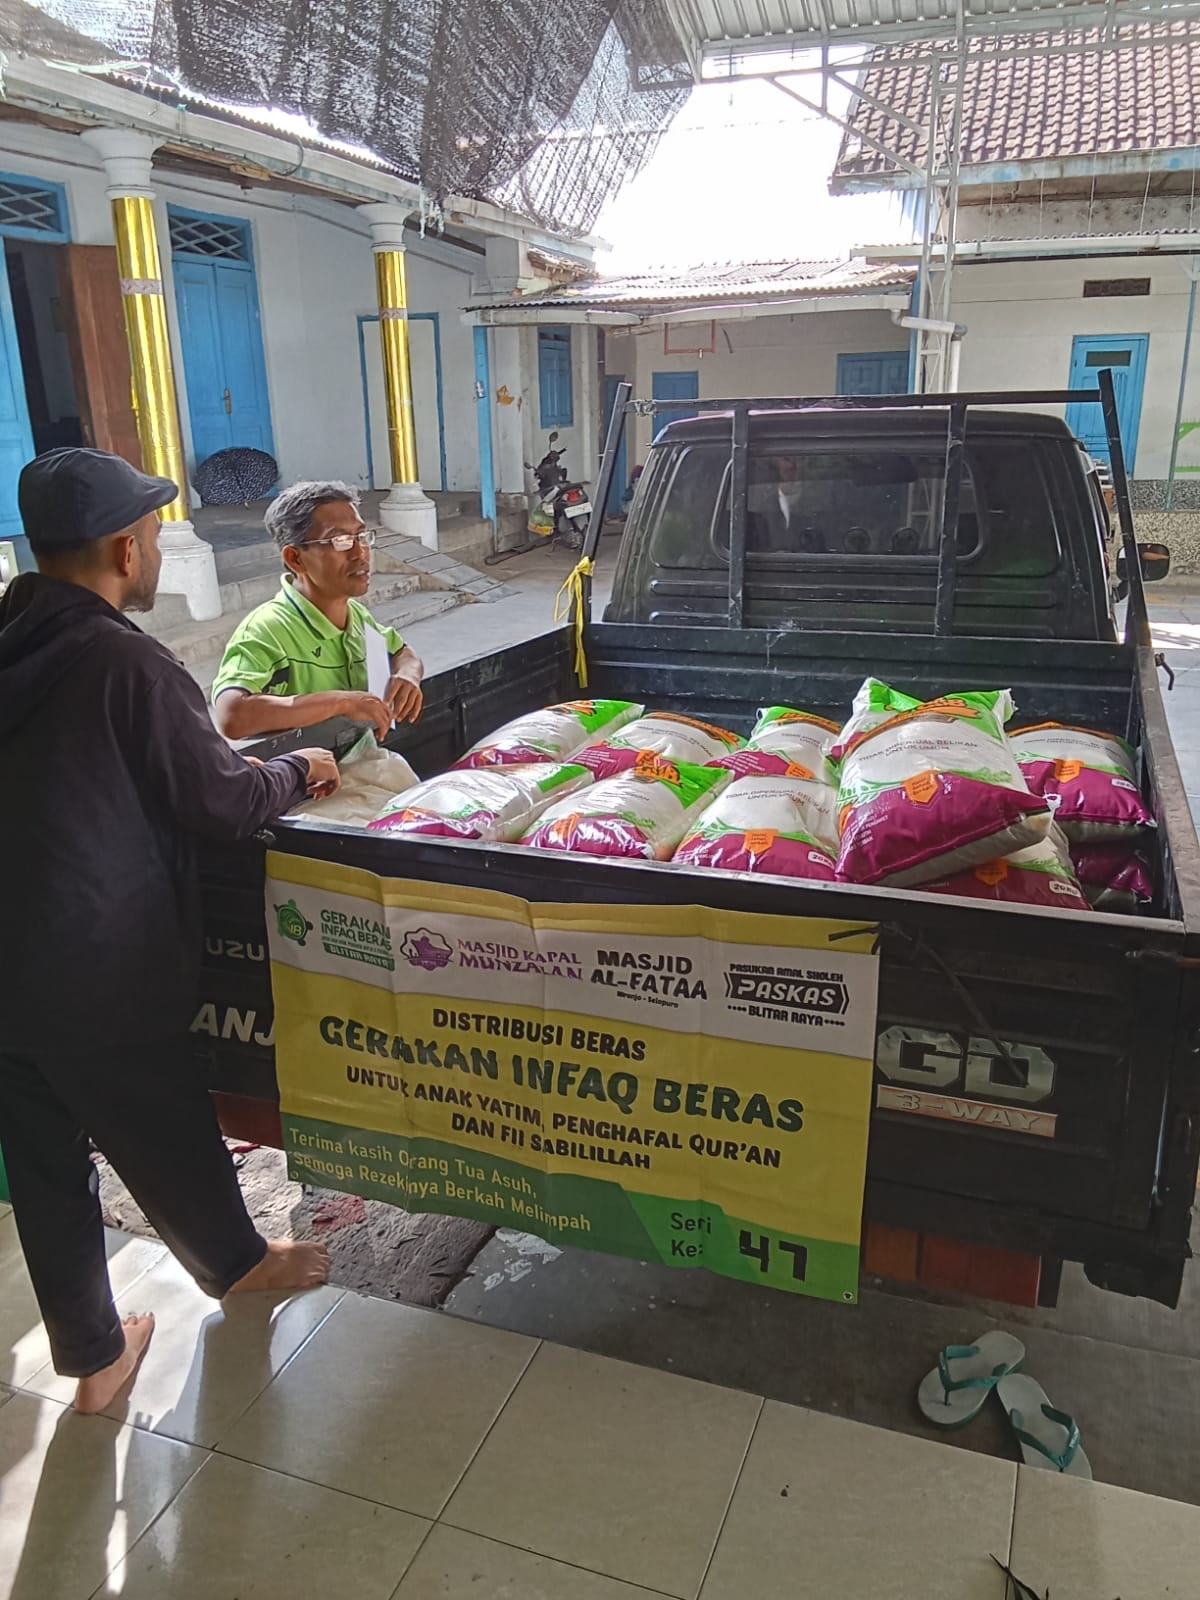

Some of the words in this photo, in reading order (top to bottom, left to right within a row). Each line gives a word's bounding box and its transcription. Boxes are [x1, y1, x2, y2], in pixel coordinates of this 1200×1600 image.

[321, 909, 391, 939] GERAKAN
[321, 922, 357, 942] INFAQ
[358, 931, 392, 951] BERAS
[205, 937, 265, 961] UZU
[457, 938, 518, 960] MASJID
[523, 950, 582, 965] KAPAL
[596, 949, 693, 975] MASJID
[458, 951, 583, 981] MUNZALAN
[729, 963, 775, 976] PASUKAN
[776, 967, 804, 978] AMAL
[806, 970, 844, 983] SHOLEH
[590, 968, 708, 1001] AL-FATAA
[737, 978, 837, 1007] PASKAS
[188, 1002, 275, 1047] ANJ
[748, 1005, 788, 1022] BLITAR
[791, 1012, 824, 1027] RAYA
[432, 1008, 564, 1047] DISTRIBUSI
[570, 1027, 646, 1062] BERAS
[319, 1015, 499, 1080] GERAKAN
[511, 1054, 639, 1115] INFAQ
[653, 1078, 805, 1133] BERAS
[346, 1064, 410, 1098] UNTUK
[414, 1083, 473, 1109] ANAK
[476, 1093, 546, 1132] YATIM,
[552, 1112, 684, 1150] PENGHAFAL
[451, 1112, 496, 1139] DAN
[500, 1124, 525, 1148] FII
[529, 1136, 650, 1170] SABILILLAH
[289, 1127, 344, 1155] Terima
[349, 1139, 394, 1164] kasih
[399, 1149, 449, 1177] Orang
[454, 1158, 486, 1182] Tua
[491, 1171, 538, 1200] Asuh,
[293, 1151, 355, 1182] Semoga
[359, 1163, 439, 1201] Rezekinya
[445, 1182, 505, 1211] Berkah
[511, 1196, 592, 1235] Melimpah
[670, 1211, 713, 1235] Seri
[738, 1228, 809, 1282] 47
[671, 1239, 703, 1259] Ke:
